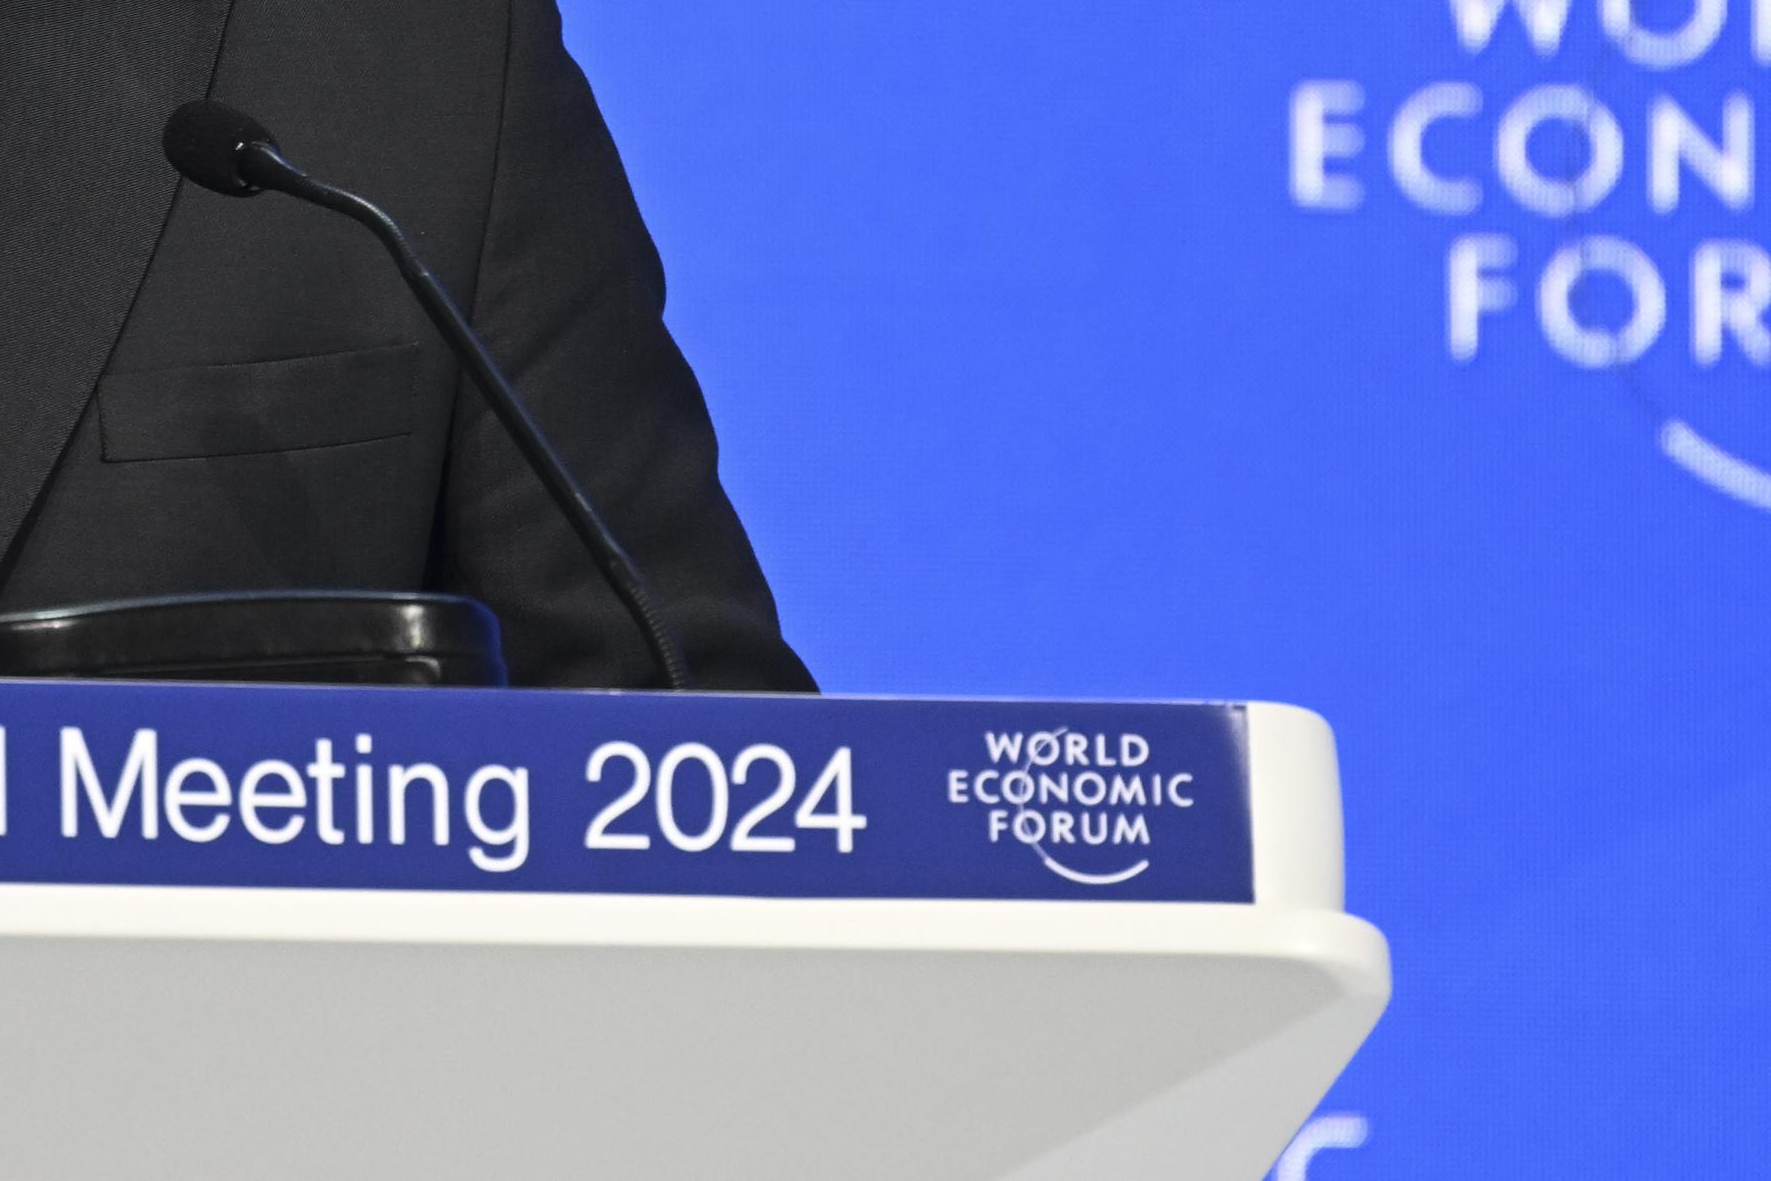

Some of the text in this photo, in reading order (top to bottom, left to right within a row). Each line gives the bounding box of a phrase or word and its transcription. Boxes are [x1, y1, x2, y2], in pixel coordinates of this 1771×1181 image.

[1288, 80, 1756, 217] ECON
[1446, 233, 1771, 368] FOR
[947, 769, 1194, 808] ECONOMIC
[984, 731, 1150, 768] WORLD
[58, 726, 531, 873] Meeting
[584, 740, 868, 854] 2024
[988, 808, 1151, 846] FORUM
